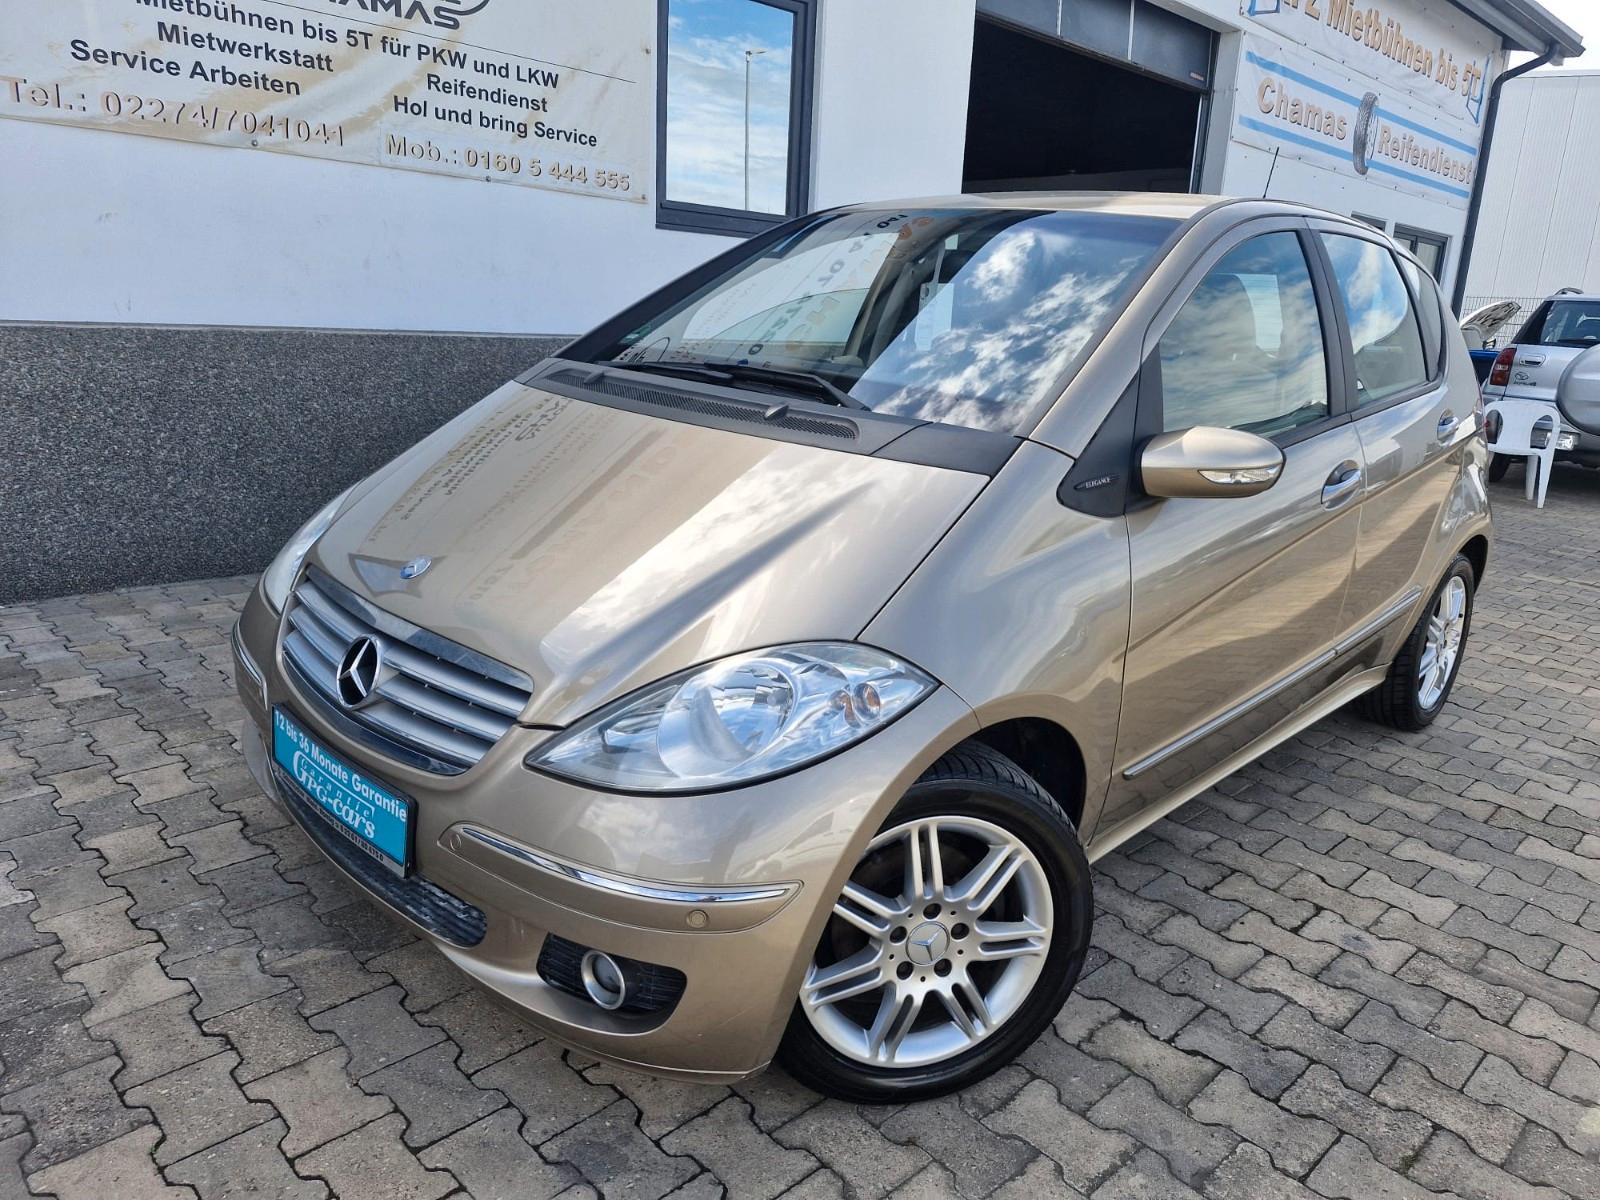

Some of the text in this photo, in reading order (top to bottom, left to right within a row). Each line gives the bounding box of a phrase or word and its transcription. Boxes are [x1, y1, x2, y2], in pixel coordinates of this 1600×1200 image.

[329, 0, 461, 30] MAS
[71, 39, 300, 95] Service Arbeiten
[157, 21, 333, 72] Mietwerkstatt
[303, 19, 338, 43] bis
[346, 28, 373, 50] 5T
[380, 36, 411, 57] für
[418, 43, 467, 69] PKW
[473, 59, 509, 79] und
[516, 64, 559, 88] LKW
[1326, 0, 1433, 78] Mietbühnen
[1435, 47, 1457, 91] bis
[0, 75, 87, 112] Tel.:
[427, 73, 547, 112] Reifendienst
[1256, 76, 1347, 141] Chamas
[393, 95, 597, 148] Hol und bring Service
[386, 134, 458, 164] Mob.:
[464, 147, 521, 173] 0160
[528, 158, 542, 177] 5
[549, 162, 588, 184] 444
[1377, 125, 1473, 185] Reifendienst
[275, 710, 407, 822] 12 bis 36 Monate Garantie
